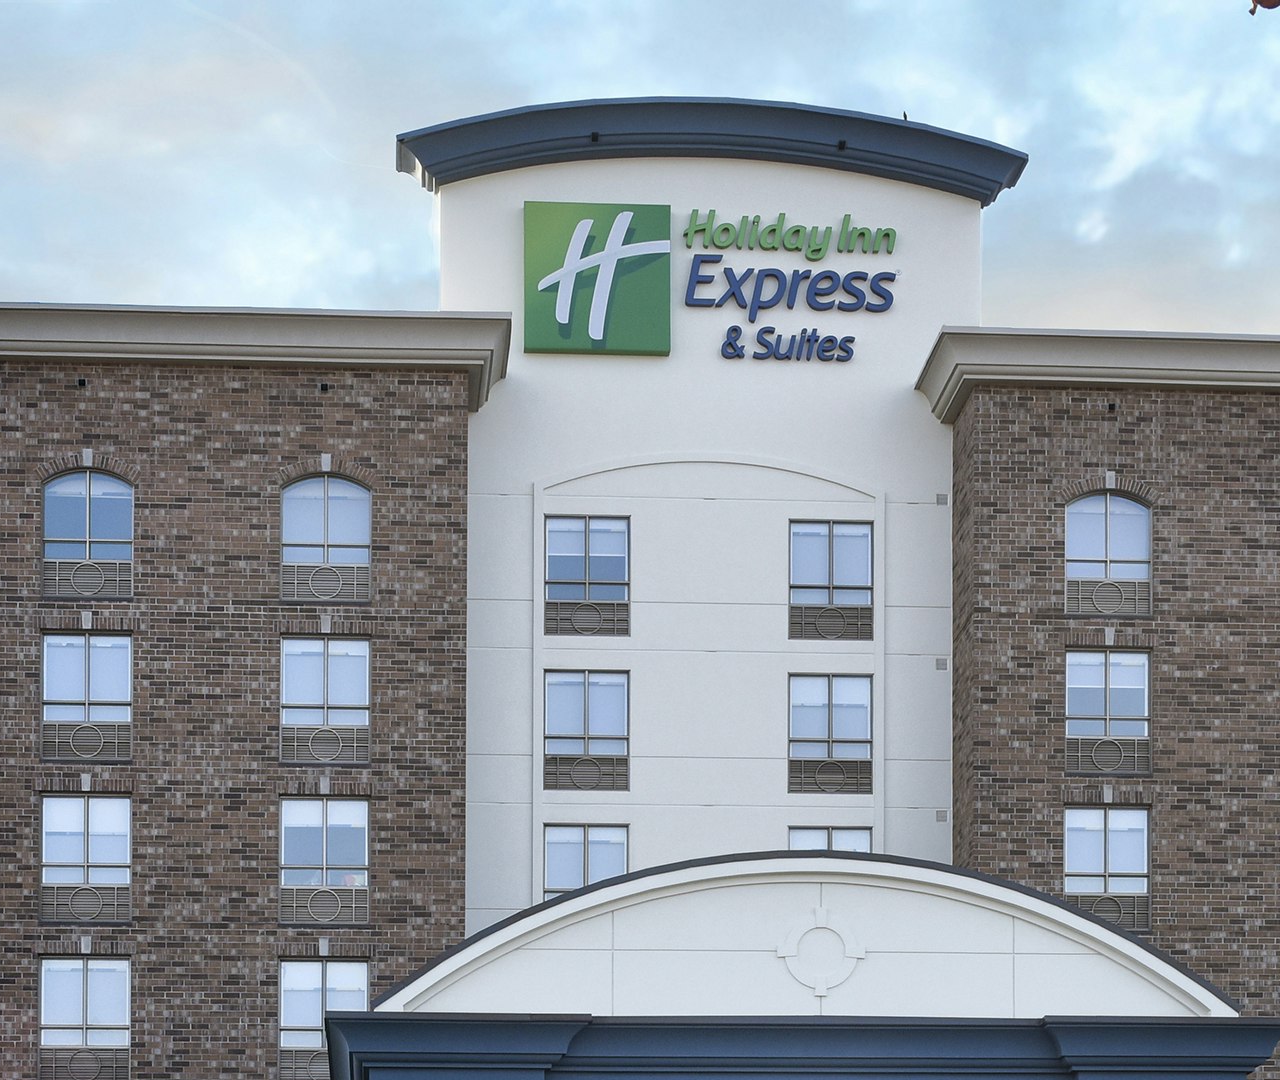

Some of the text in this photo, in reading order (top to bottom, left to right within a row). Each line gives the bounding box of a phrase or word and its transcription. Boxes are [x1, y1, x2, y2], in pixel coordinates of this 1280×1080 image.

[683, 208, 898, 262] Holiday Inn
[684, 254, 896, 324] Express
[720, 325, 856, 363] & Suites
